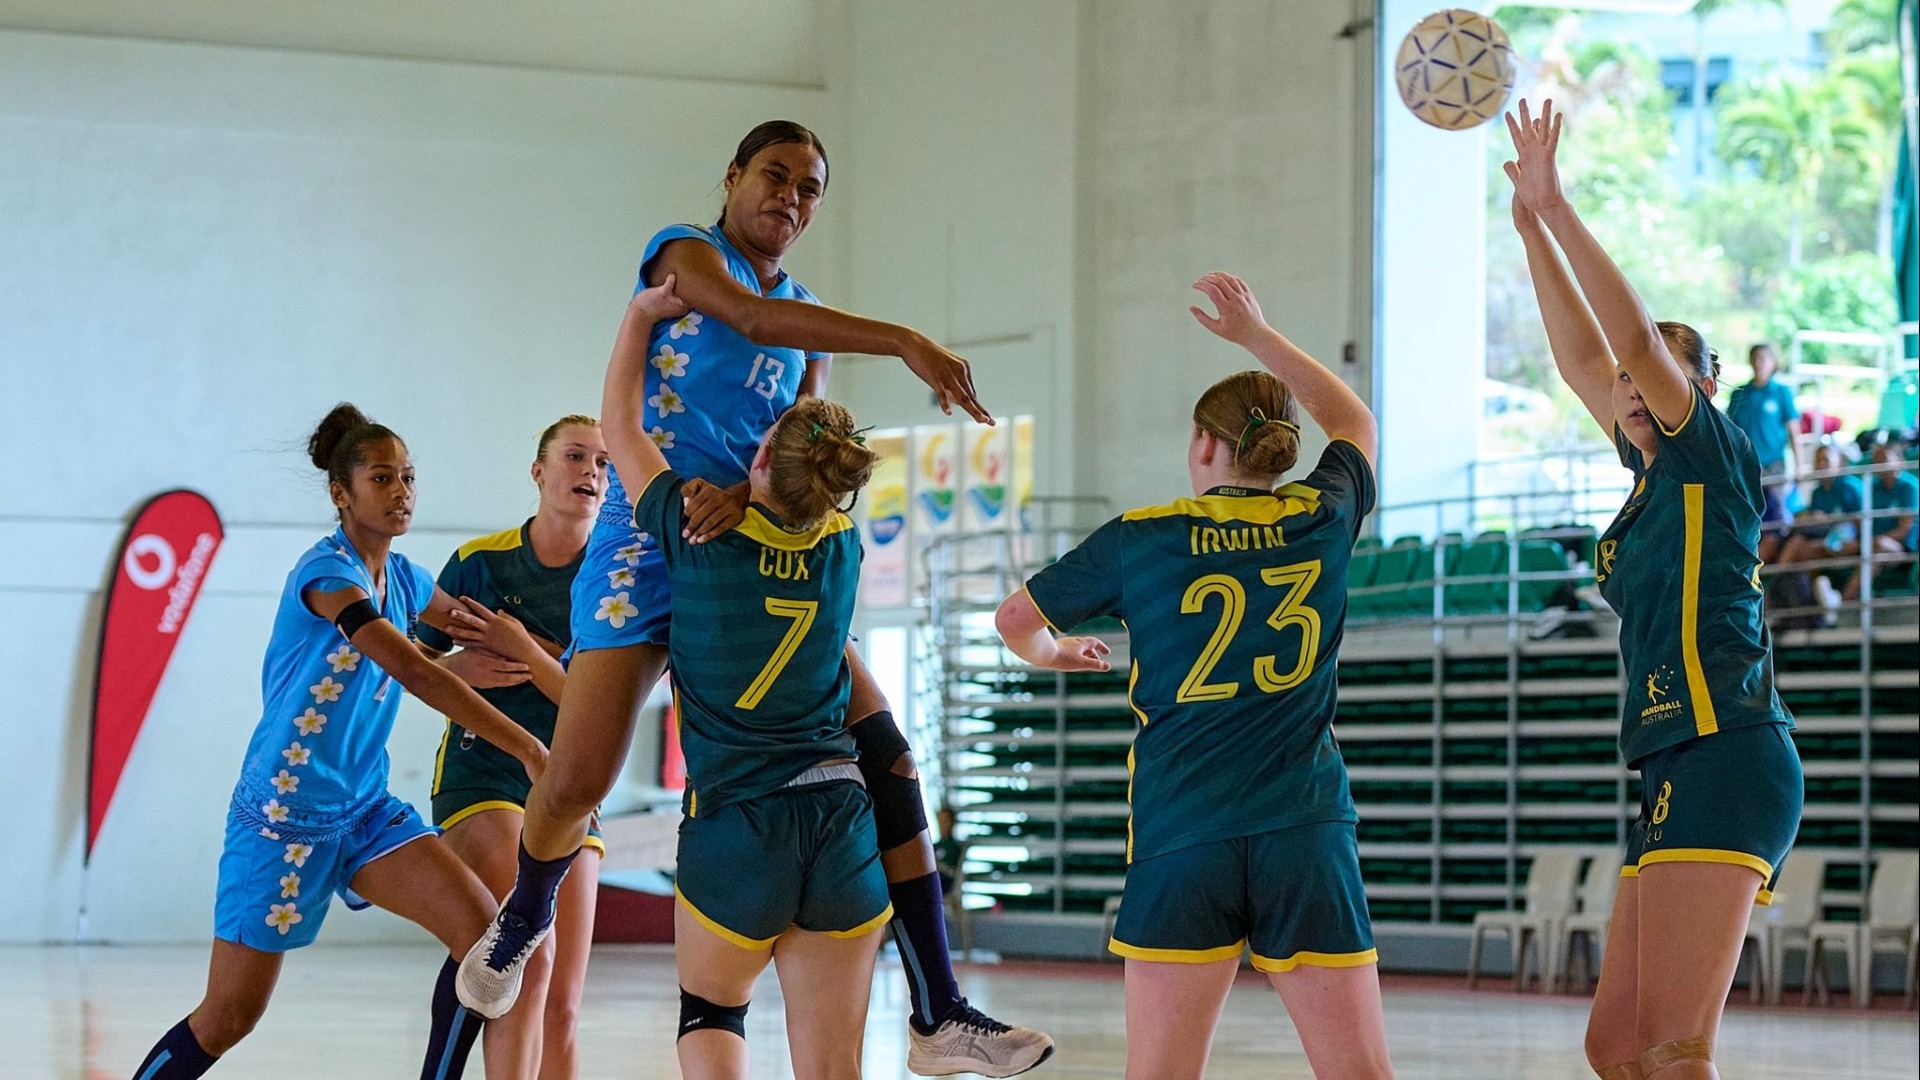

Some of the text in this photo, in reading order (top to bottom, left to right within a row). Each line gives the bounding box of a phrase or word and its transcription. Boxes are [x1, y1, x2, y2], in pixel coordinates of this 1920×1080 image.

[744, 352, 785, 400] 13
[1190, 525, 1287, 555] IRWIN
[157, 532, 216, 633] vodafone
[759, 546, 809, 580] COX
[1176, 559, 1321, 703] 23
[735, 596, 819, 711] 7
[1641, 700, 1682, 717] HANDBALL
[1641, 709, 1683, 727] AUSTRALIA
